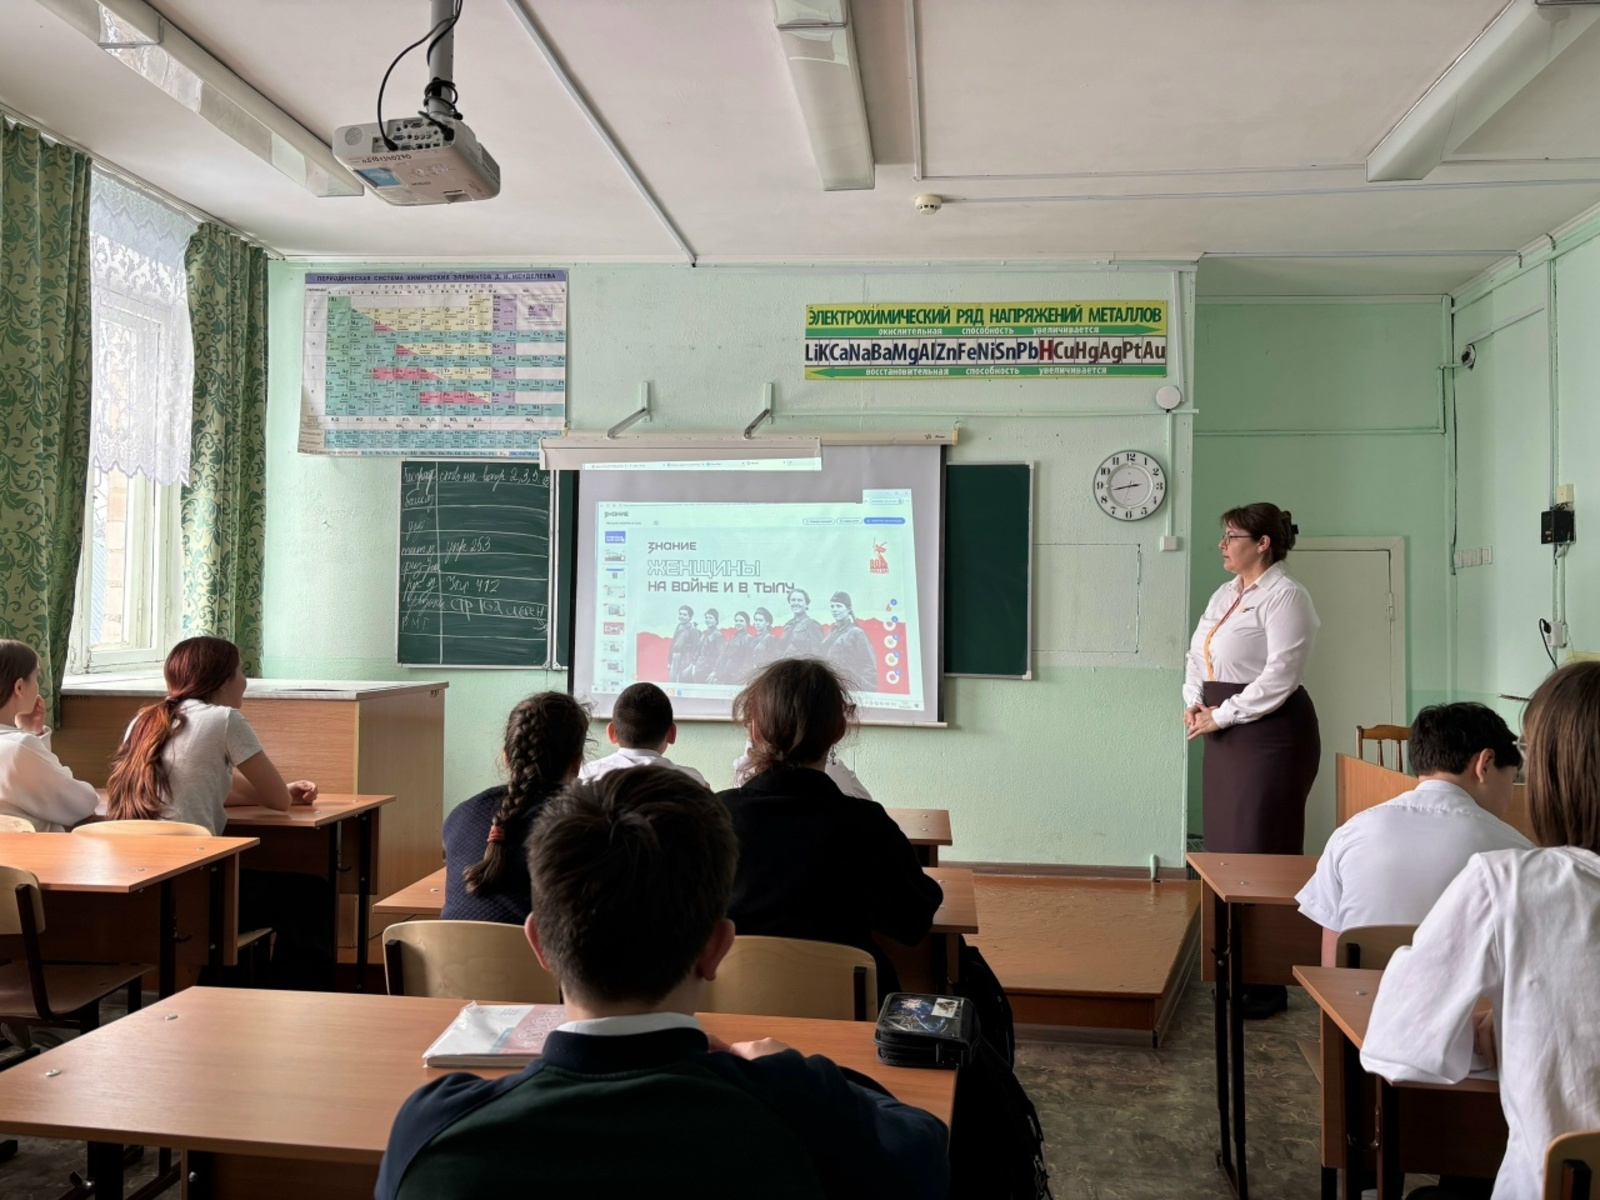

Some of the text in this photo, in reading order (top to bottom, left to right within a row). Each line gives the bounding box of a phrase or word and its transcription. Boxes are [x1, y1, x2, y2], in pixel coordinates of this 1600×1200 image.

[808, 305, 1162, 326] ЭЛЕКТРОХИМИЧЕСКИЙ РЯД НАПРЯЖЕНИЙ МЕТАЛЛОВ
[878, 326, 1100, 336] окислительная способность увеличивается
[865, 366, 1107, 376] восстановительная способность увеличивается
[1112, 457, 1120, 465] 11
[1126, 453, 1136, 462] 12
[1100, 467, 1111, 475] 10
[1152, 467, 1159, 476] 2
[1096, 481, 1104, 490] 9
[1156, 482, 1163, 490] 3
[1101, 496, 1108, 504] 8
[1110, 505, 1117, 515] 7
[1141, 507, 1147, 515] 5
[469, 536, 491, 552] 253
[647, 559, 760, 579] ЖЕНЩИНЫ
[476, 579, 501, 593] 412
[648, 577, 795, 593] НА ВОЙНЕ И В ТЫЛУ
